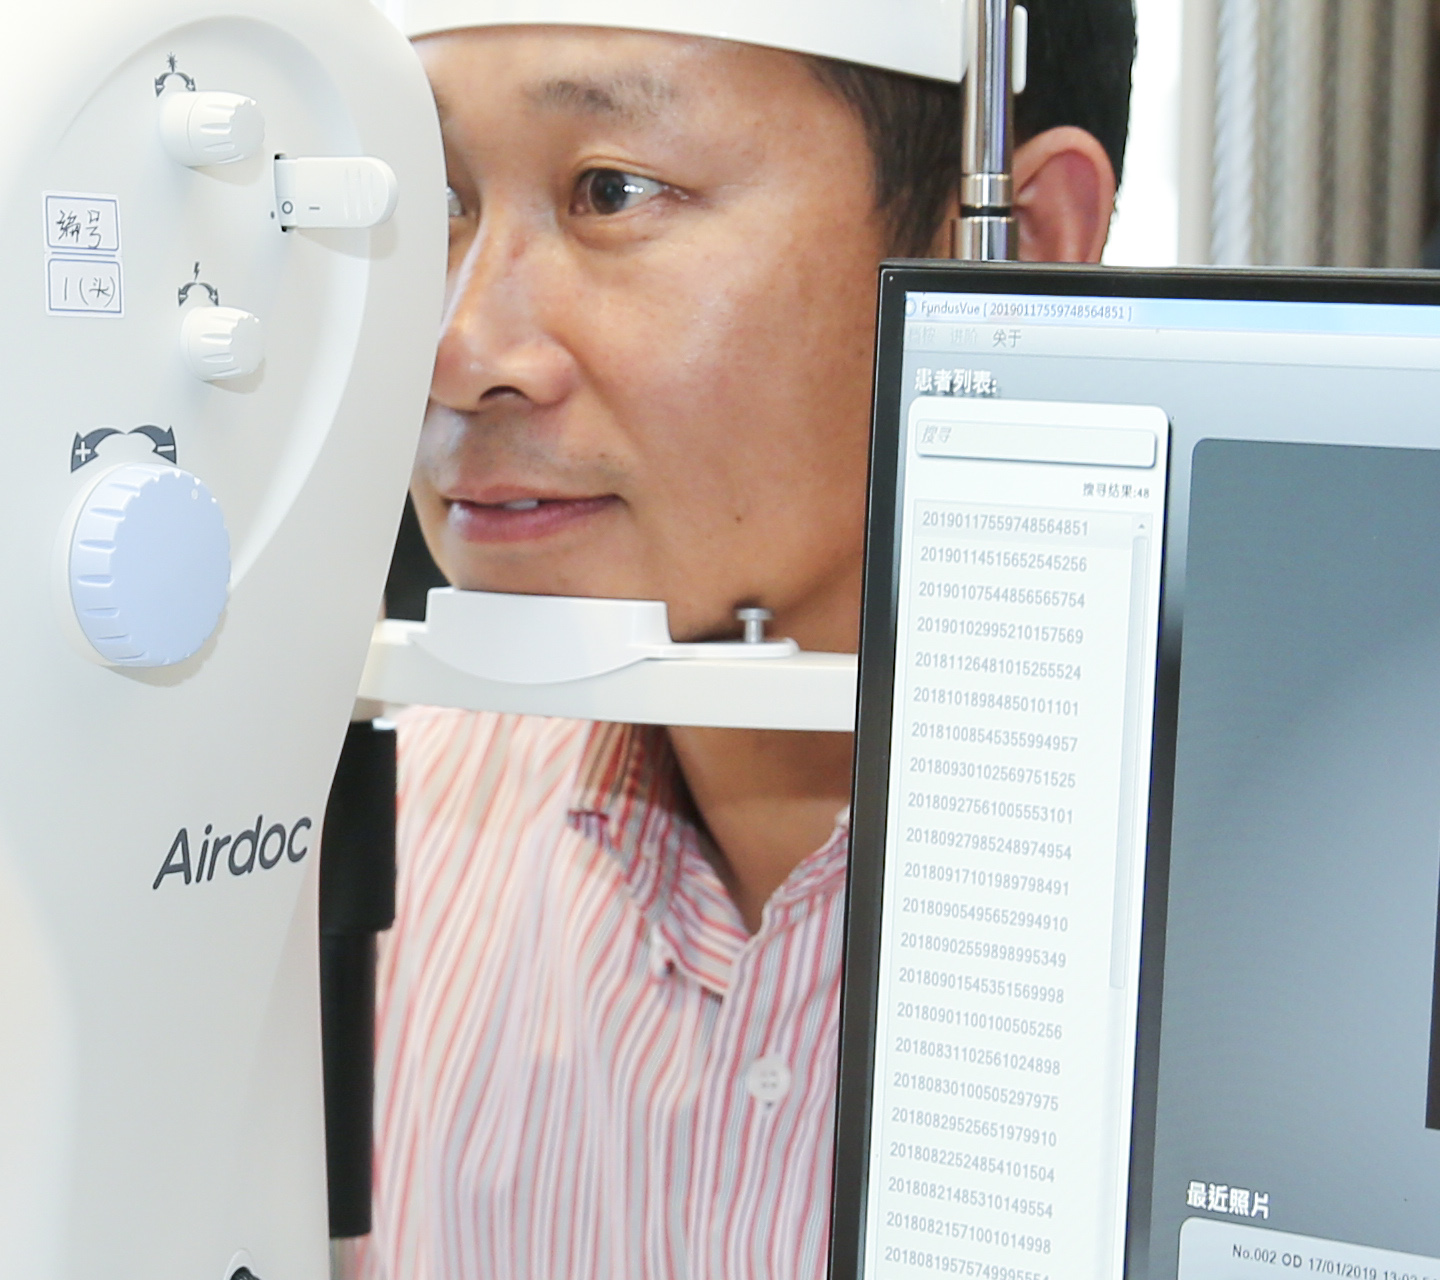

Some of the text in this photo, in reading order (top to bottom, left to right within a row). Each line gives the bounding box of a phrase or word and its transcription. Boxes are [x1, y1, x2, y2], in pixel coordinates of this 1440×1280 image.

[56, 209, 102, 249] 编号
[920, 300, 980, 317] FundusVue
[992, 328, 1022, 348] 关于
[923, 511, 1088, 535] 20190117559748564851
[152, 814, 312, 890] Airdoc
[1186, 1180, 1271, 1220] 最近照片
[1232, 1243, 1277, 1265] No.002
[1281, 1253, 1303, 1269] OD
